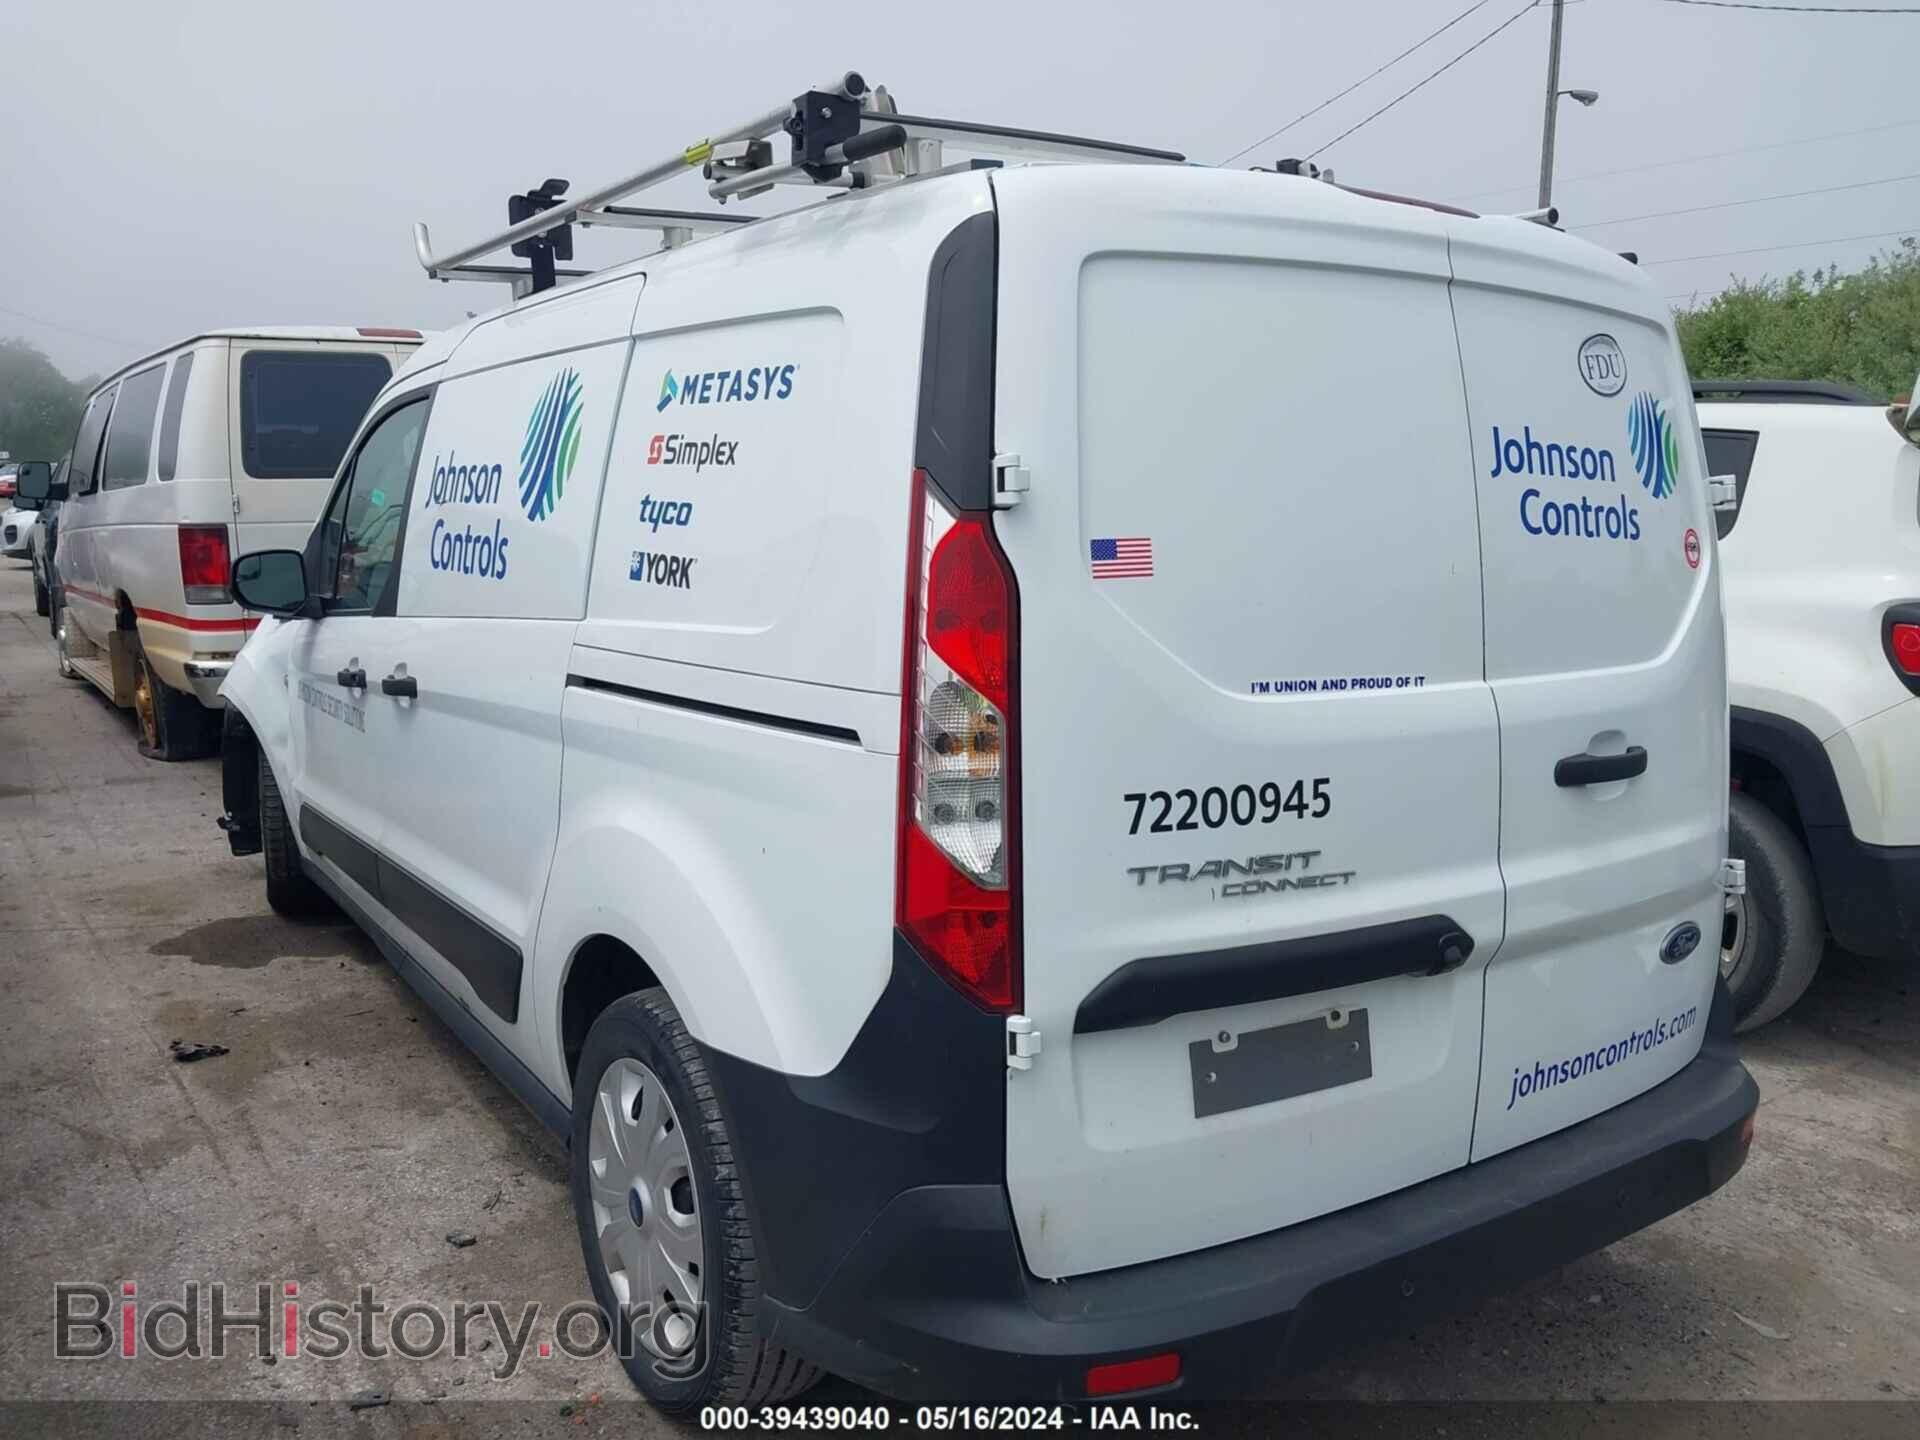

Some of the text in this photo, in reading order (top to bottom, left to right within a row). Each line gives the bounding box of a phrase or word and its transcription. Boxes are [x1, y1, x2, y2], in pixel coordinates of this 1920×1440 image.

[680, 364, 795, 405] METASYS
[1584, 353, 1621, 380] FDU
[663, 433, 739, 473] Simplex
[1490, 425, 1616, 482] Johnson
[425, 449, 502, 508] Johnson
[639, 493, 692, 533] tyco
[1520, 488, 1640, 541] Controls
[430, 518, 509, 580] Controls
[646, 552, 695, 590] YORK
[1250, 675, 1426, 694] I'M UNION AND PROUD OF IT
[1123, 777, 1331, 835] 72200945
[1126, 850, 1322, 886] TRANSIT
[1221, 870, 1357, 899] CONNECT
[1507, 1005, 1697, 1111] johnsoncontrols.com
